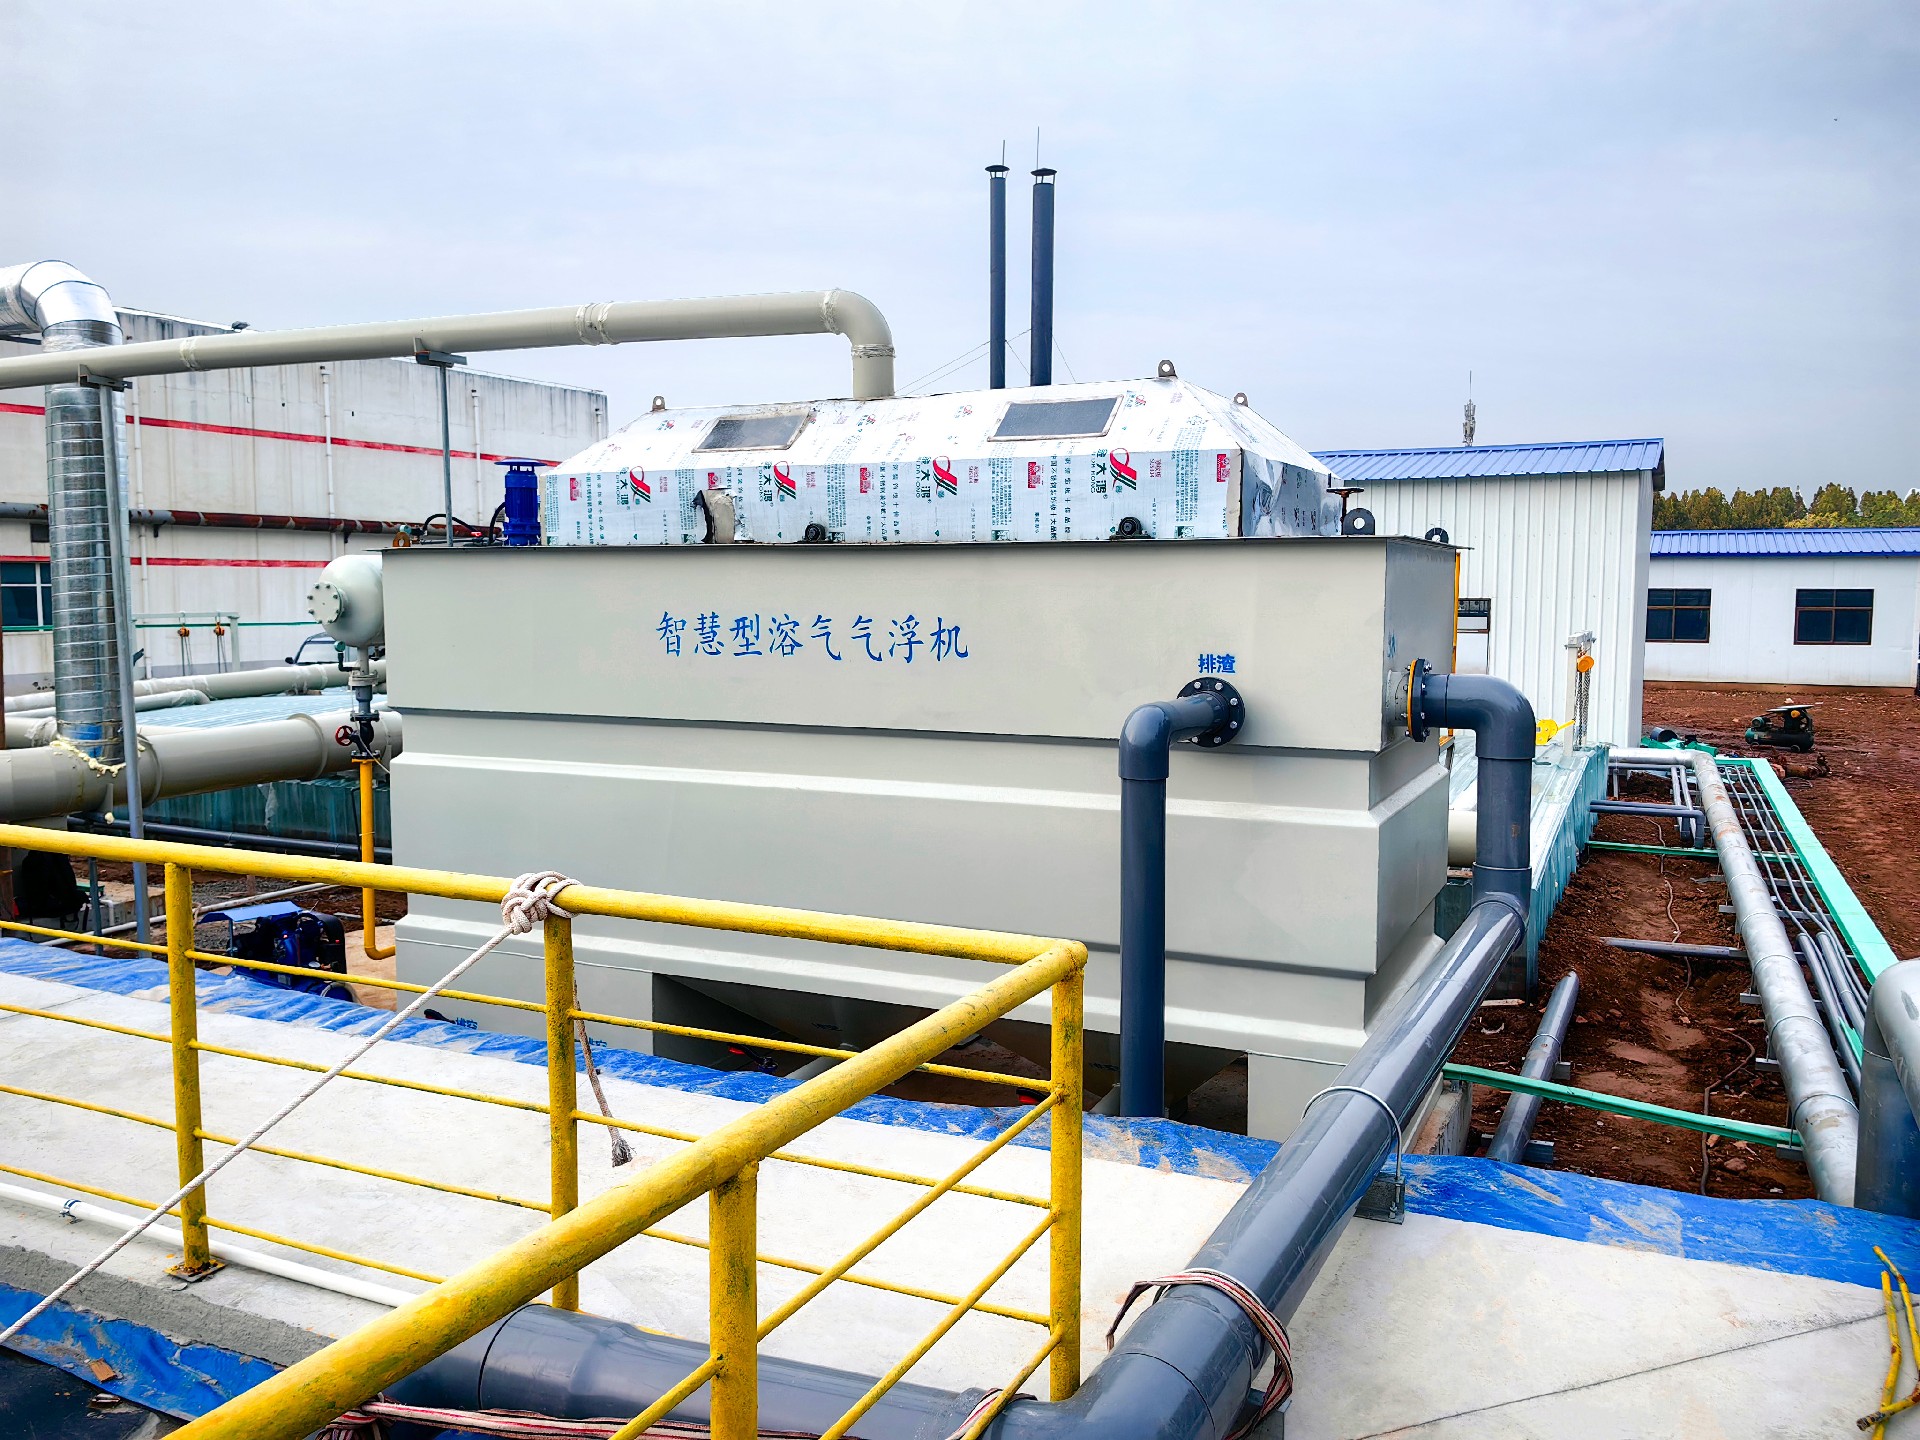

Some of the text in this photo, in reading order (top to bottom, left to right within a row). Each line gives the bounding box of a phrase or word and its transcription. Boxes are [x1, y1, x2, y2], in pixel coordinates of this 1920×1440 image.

[655, 610, 969, 664] 智慧型溶气气浮机
[1197, 653, 1236, 674] 排渣
